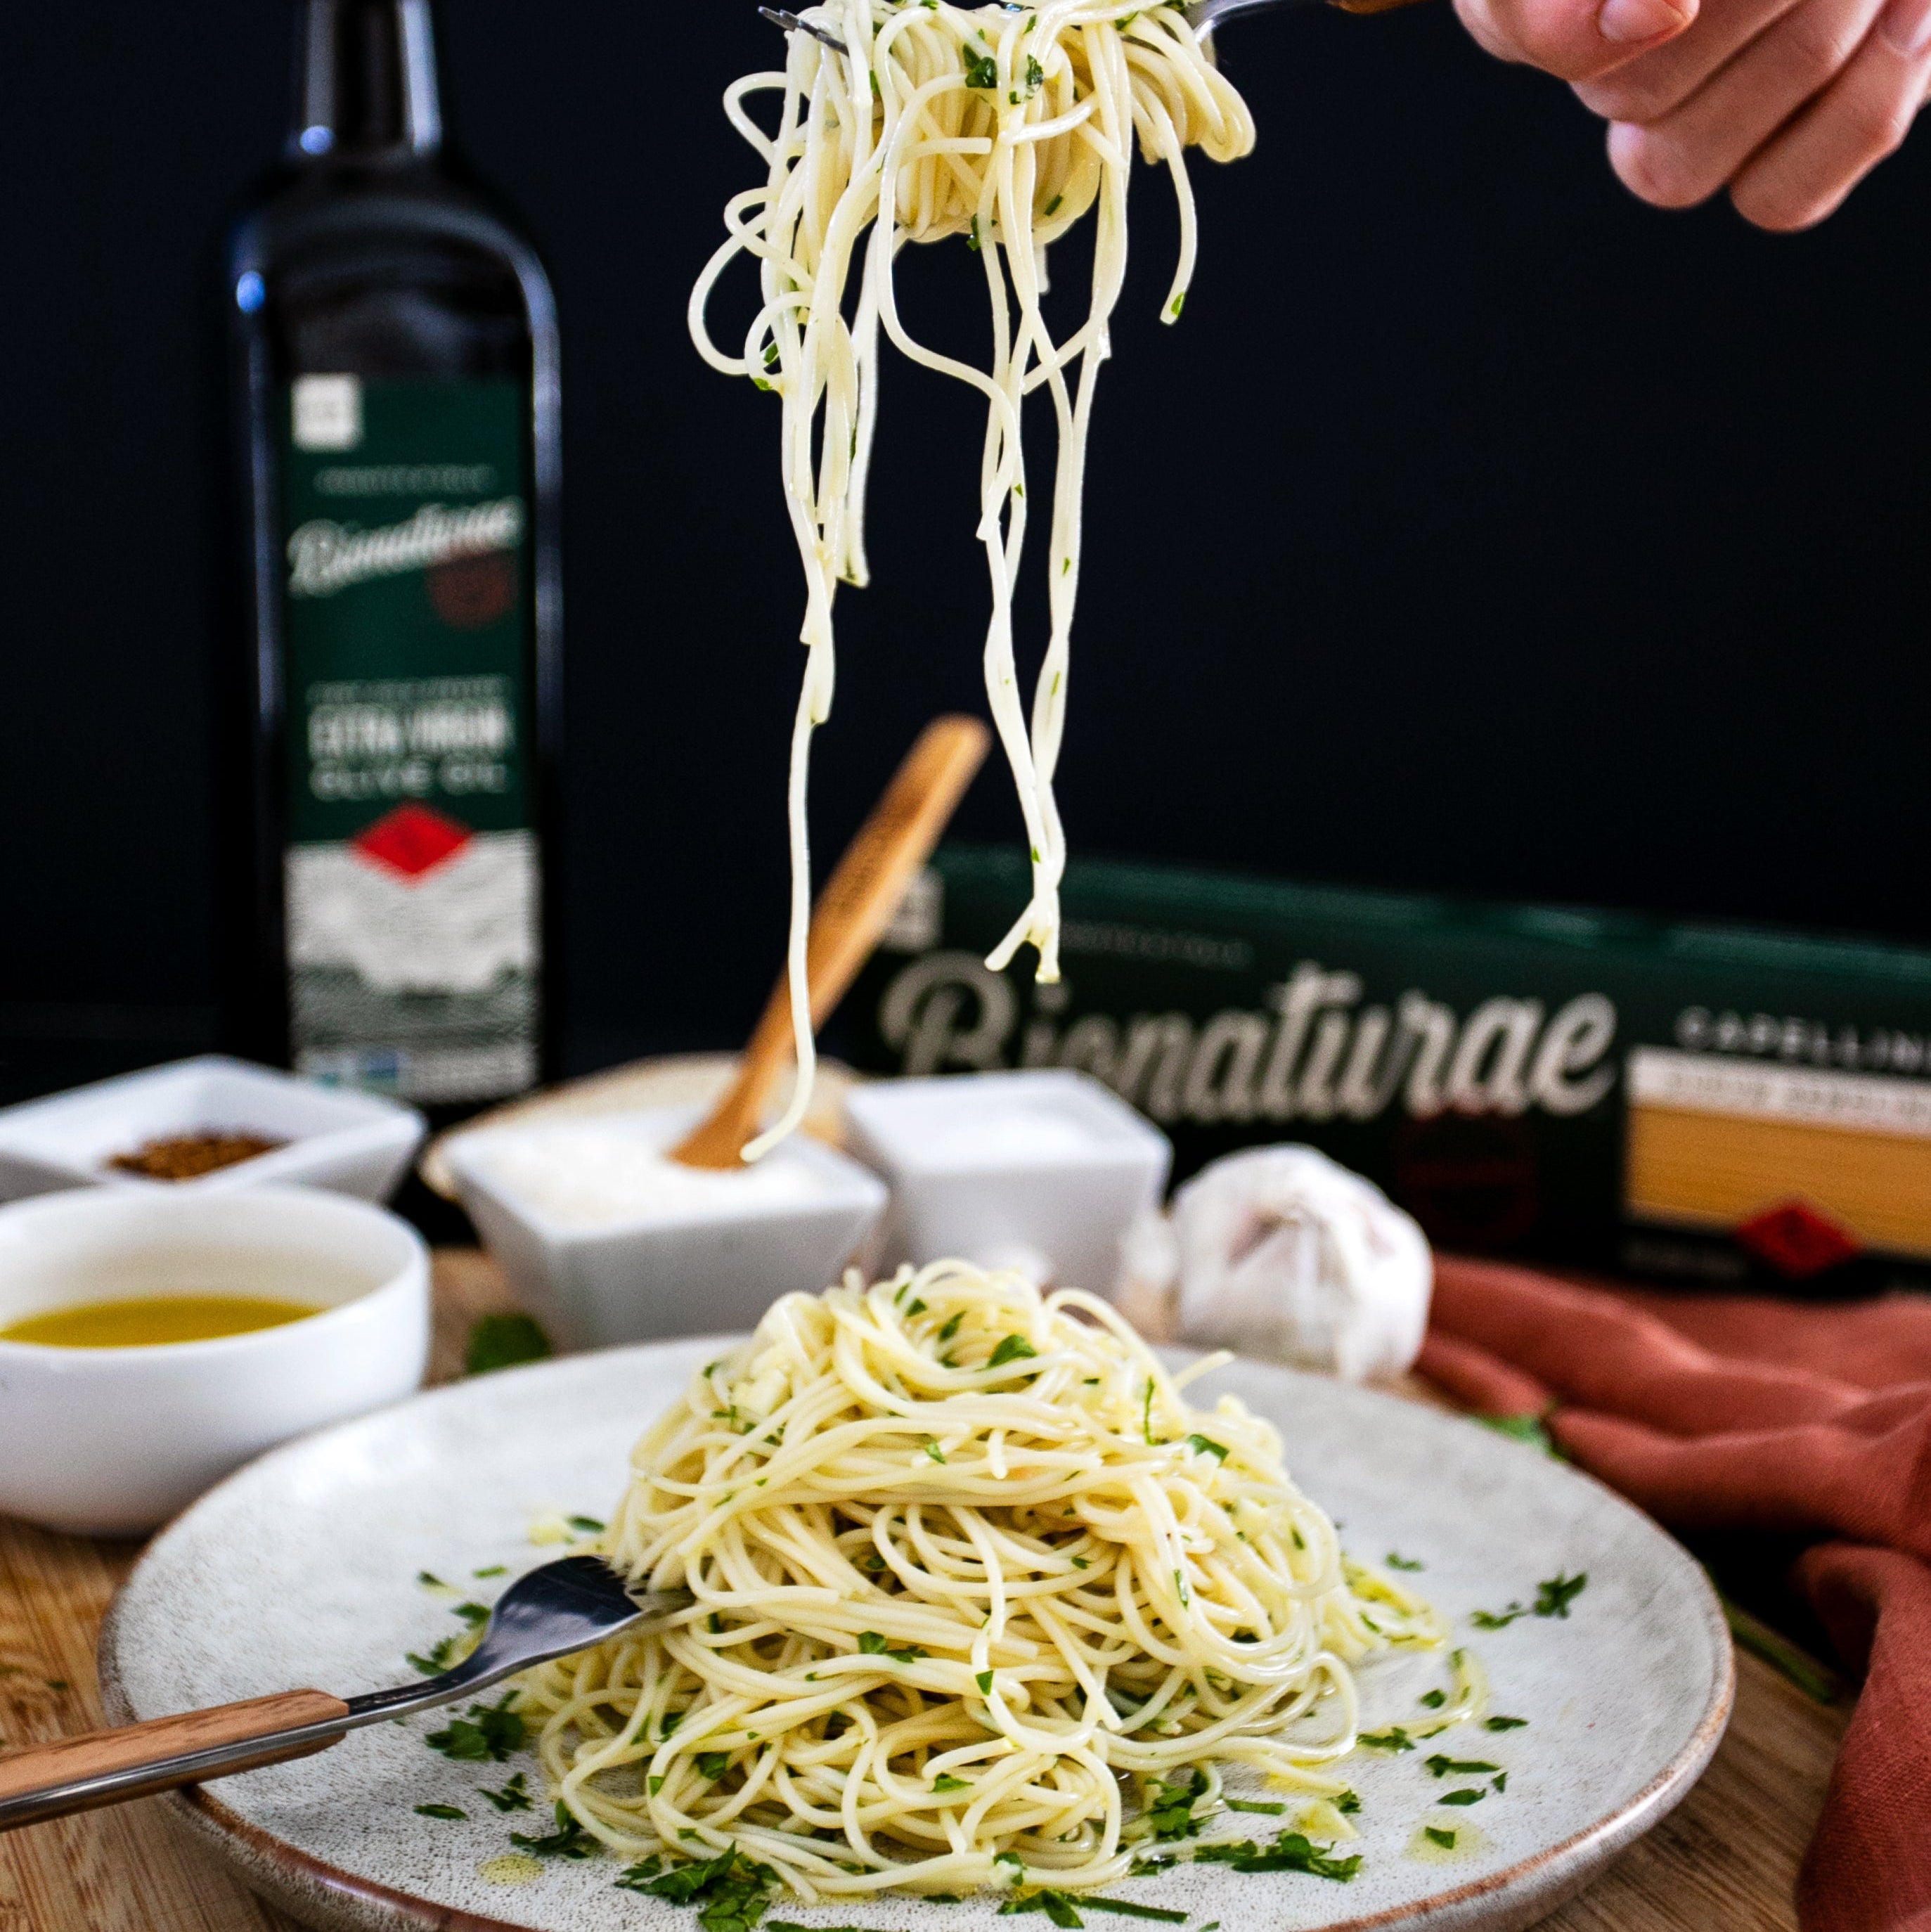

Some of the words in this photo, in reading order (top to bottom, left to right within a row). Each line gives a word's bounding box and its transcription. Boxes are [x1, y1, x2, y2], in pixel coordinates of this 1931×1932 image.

[310, 762, 427, 801] OLIVE
[440, 757, 507, 796] OIL
[1677, 1005, 1931, 1073] CAPELLIN
